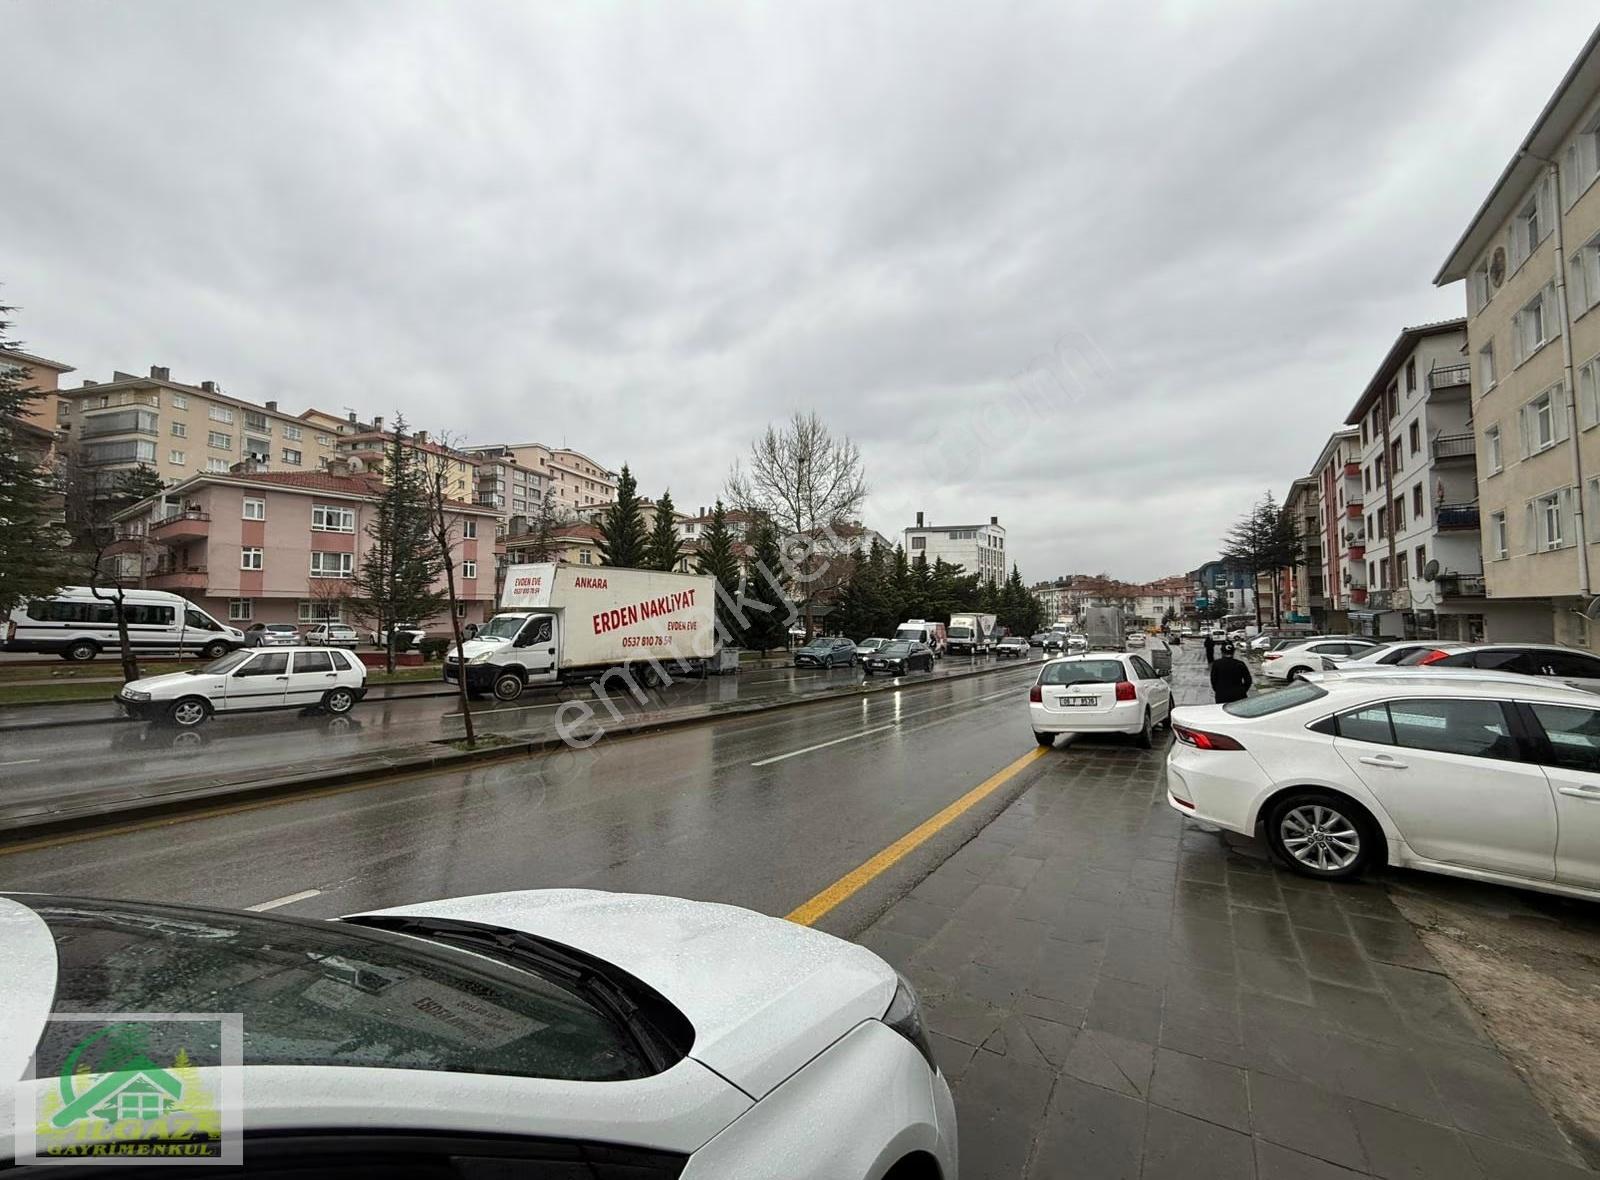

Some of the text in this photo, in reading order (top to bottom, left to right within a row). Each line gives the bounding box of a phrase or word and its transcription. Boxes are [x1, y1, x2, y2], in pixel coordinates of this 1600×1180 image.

[575, 577, 608, 589] ANKARA
[592, 605, 638, 635] ERDEN
[667, 621, 686, 631] EVDEN
[622, 637, 640, 648] 0537
[641, 637, 653, 647] 810
